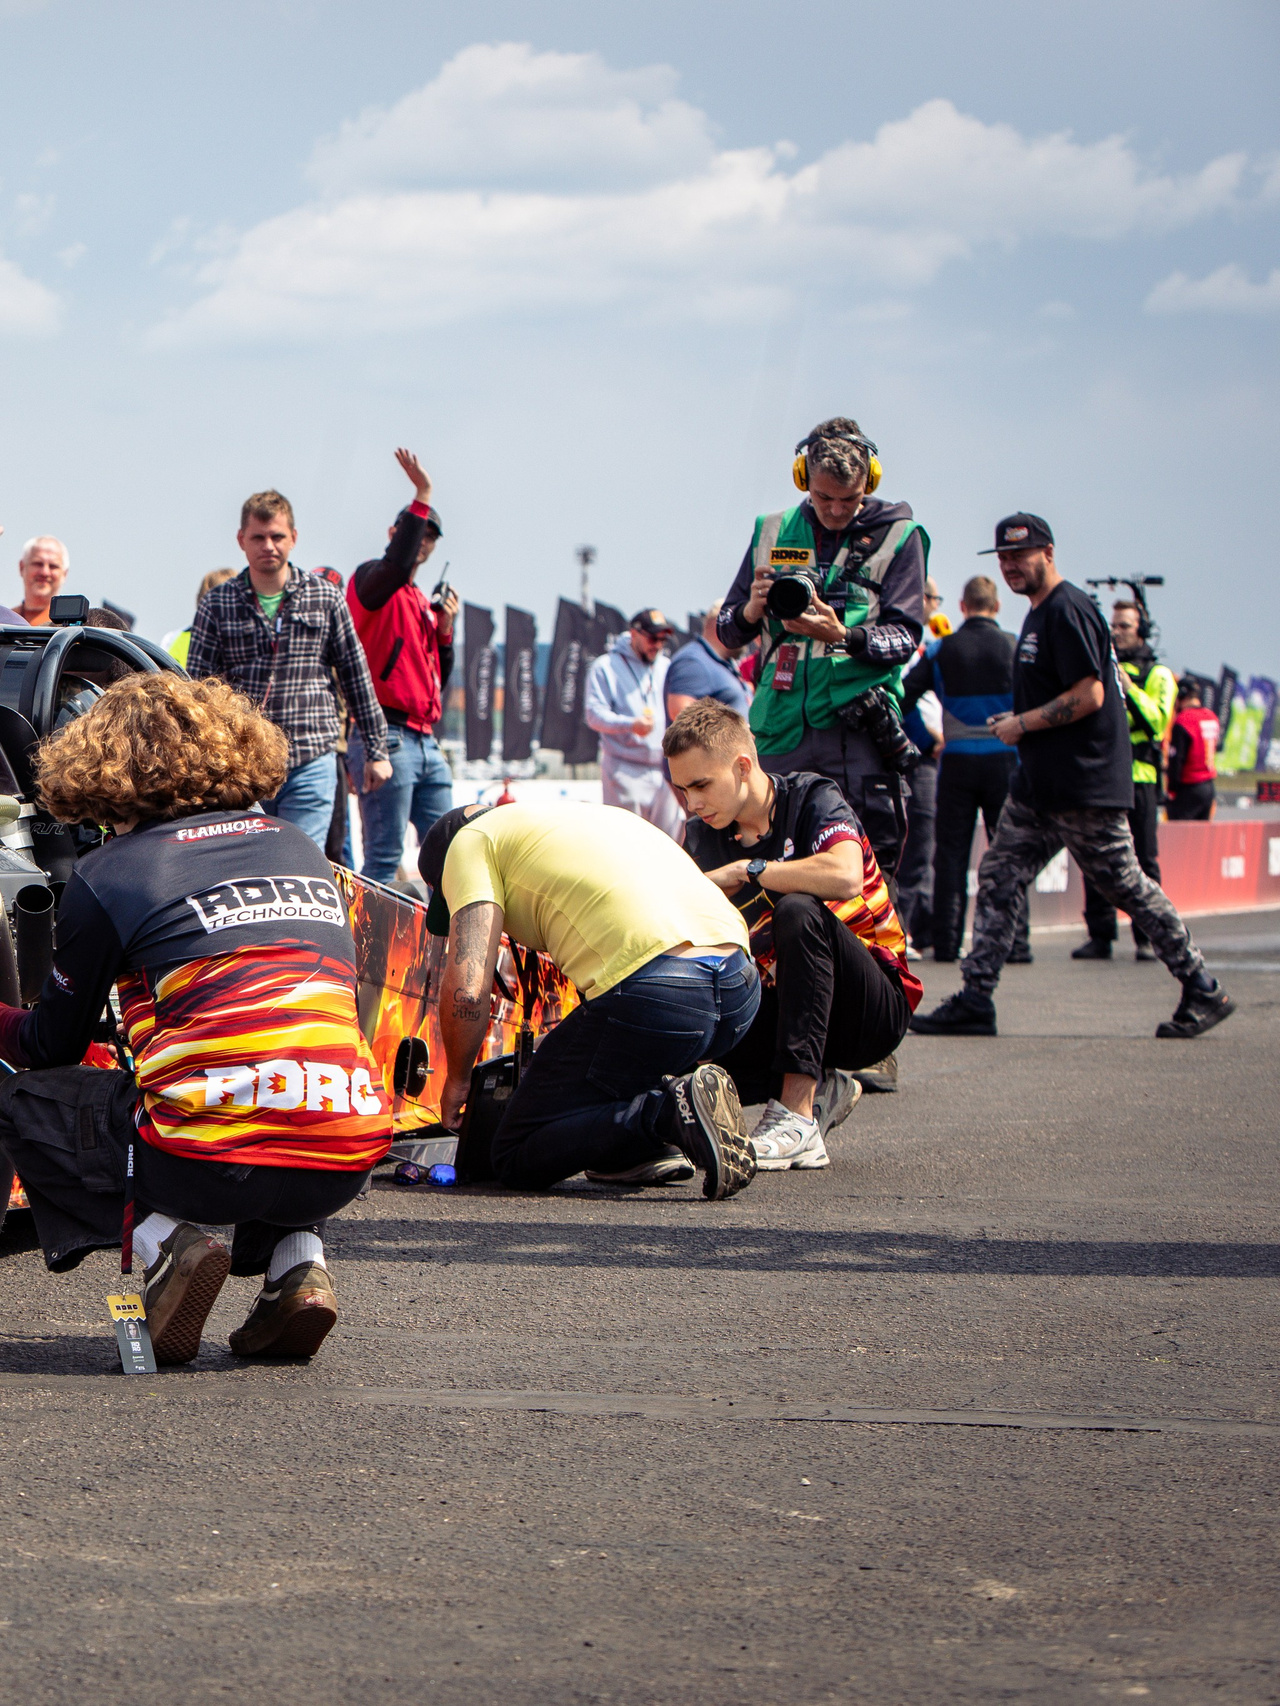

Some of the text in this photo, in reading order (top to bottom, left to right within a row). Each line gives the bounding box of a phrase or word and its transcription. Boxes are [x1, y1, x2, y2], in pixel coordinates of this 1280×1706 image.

[771, 550, 809, 560] RDRC
[177, 819, 264, 841] FLAMHOLC
[191, 878, 338, 919] RDRC
[208, 906, 342, 929] TECHNOLOGY
[452, 1004, 480, 1021] King
[205, 1059, 382, 1116] RDRC
[675, 1081, 696, 1125] HOKA
